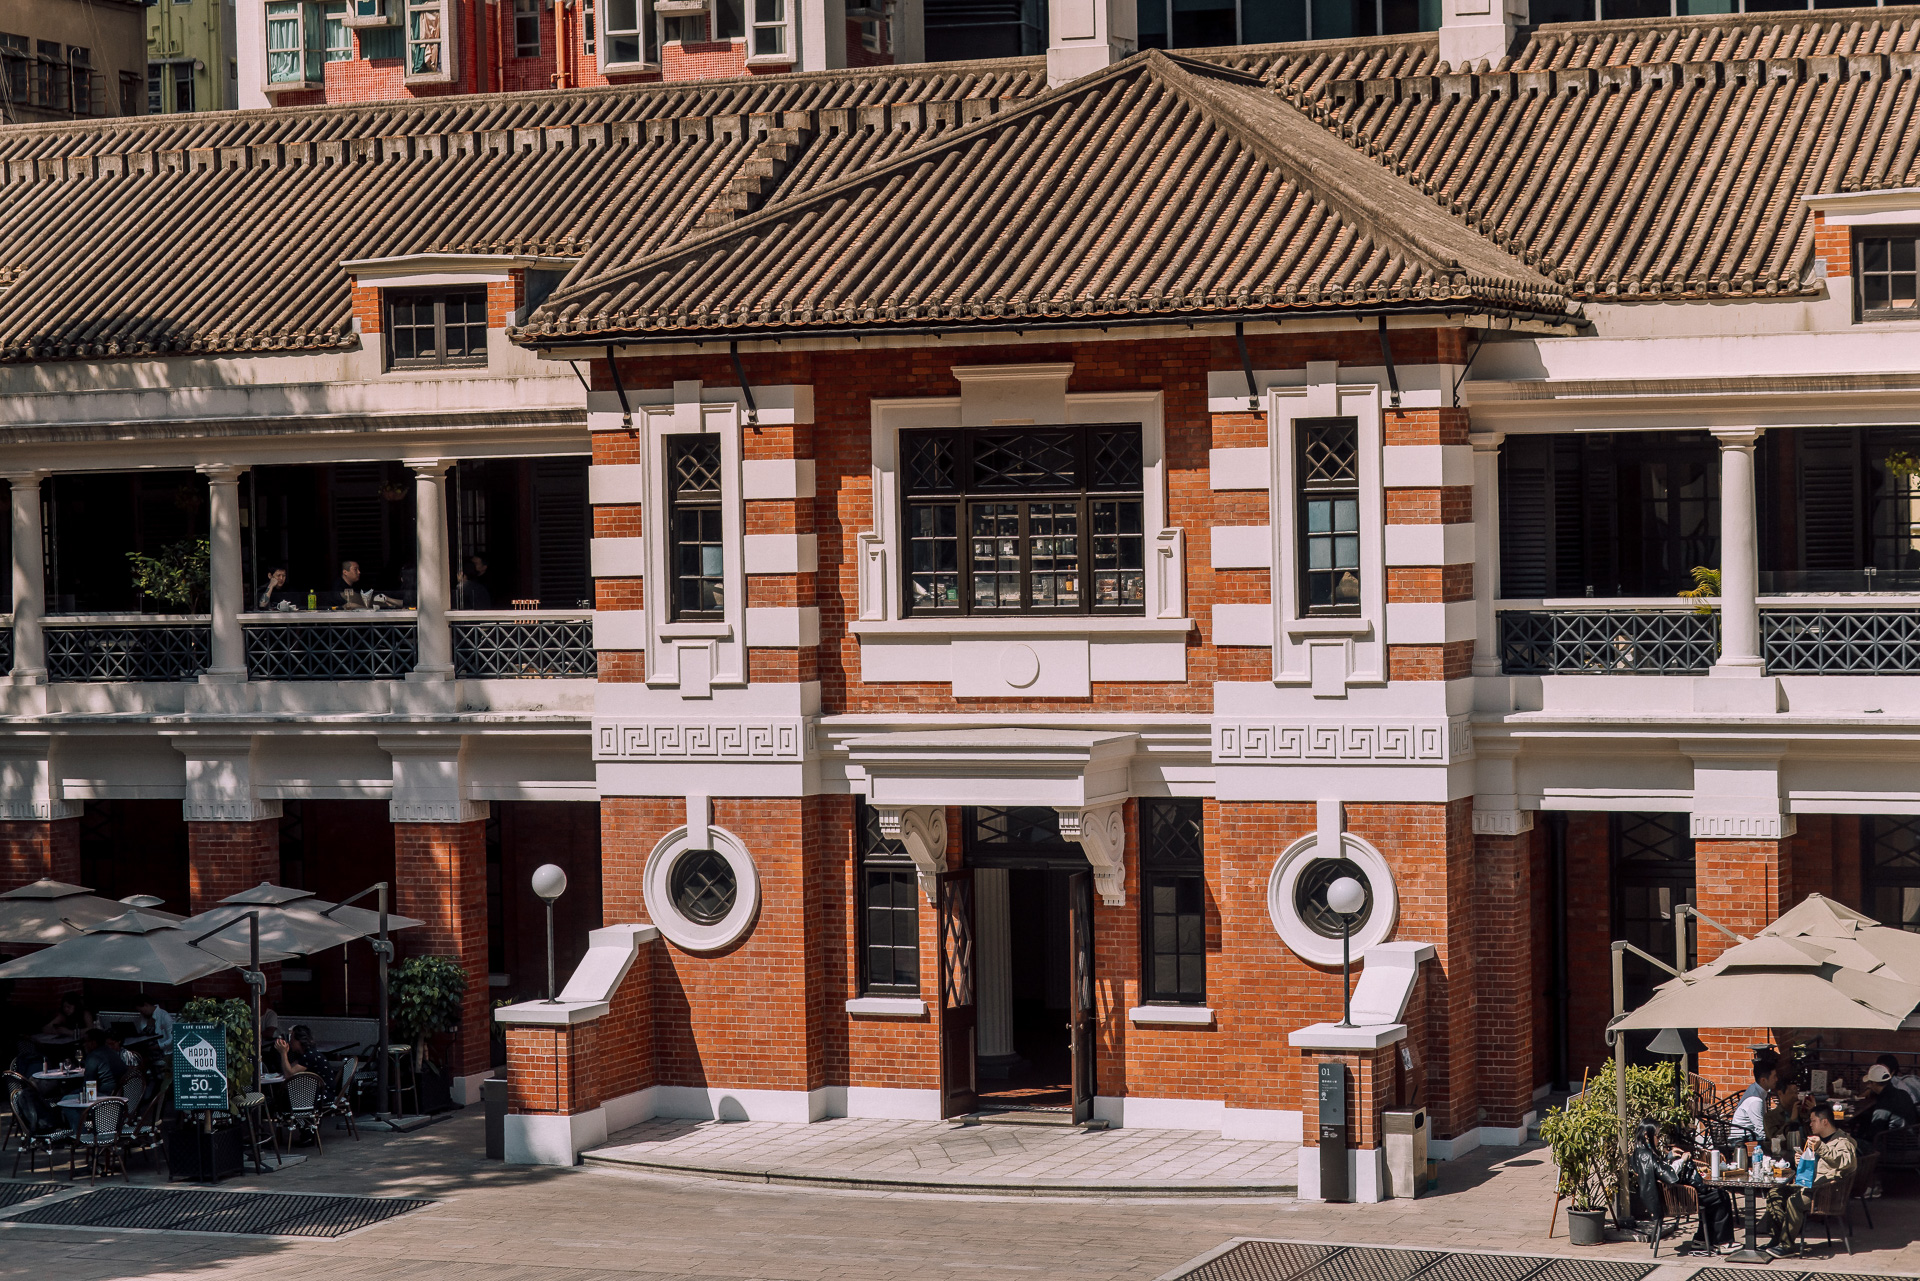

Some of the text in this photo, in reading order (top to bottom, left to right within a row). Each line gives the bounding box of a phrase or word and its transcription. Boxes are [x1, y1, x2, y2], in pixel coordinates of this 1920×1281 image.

[188, 1048, 213, 1056] HAPPY
[194, 1058, 214, 1067] HOUR
[1321, 1068, 1330, 1076] 01
